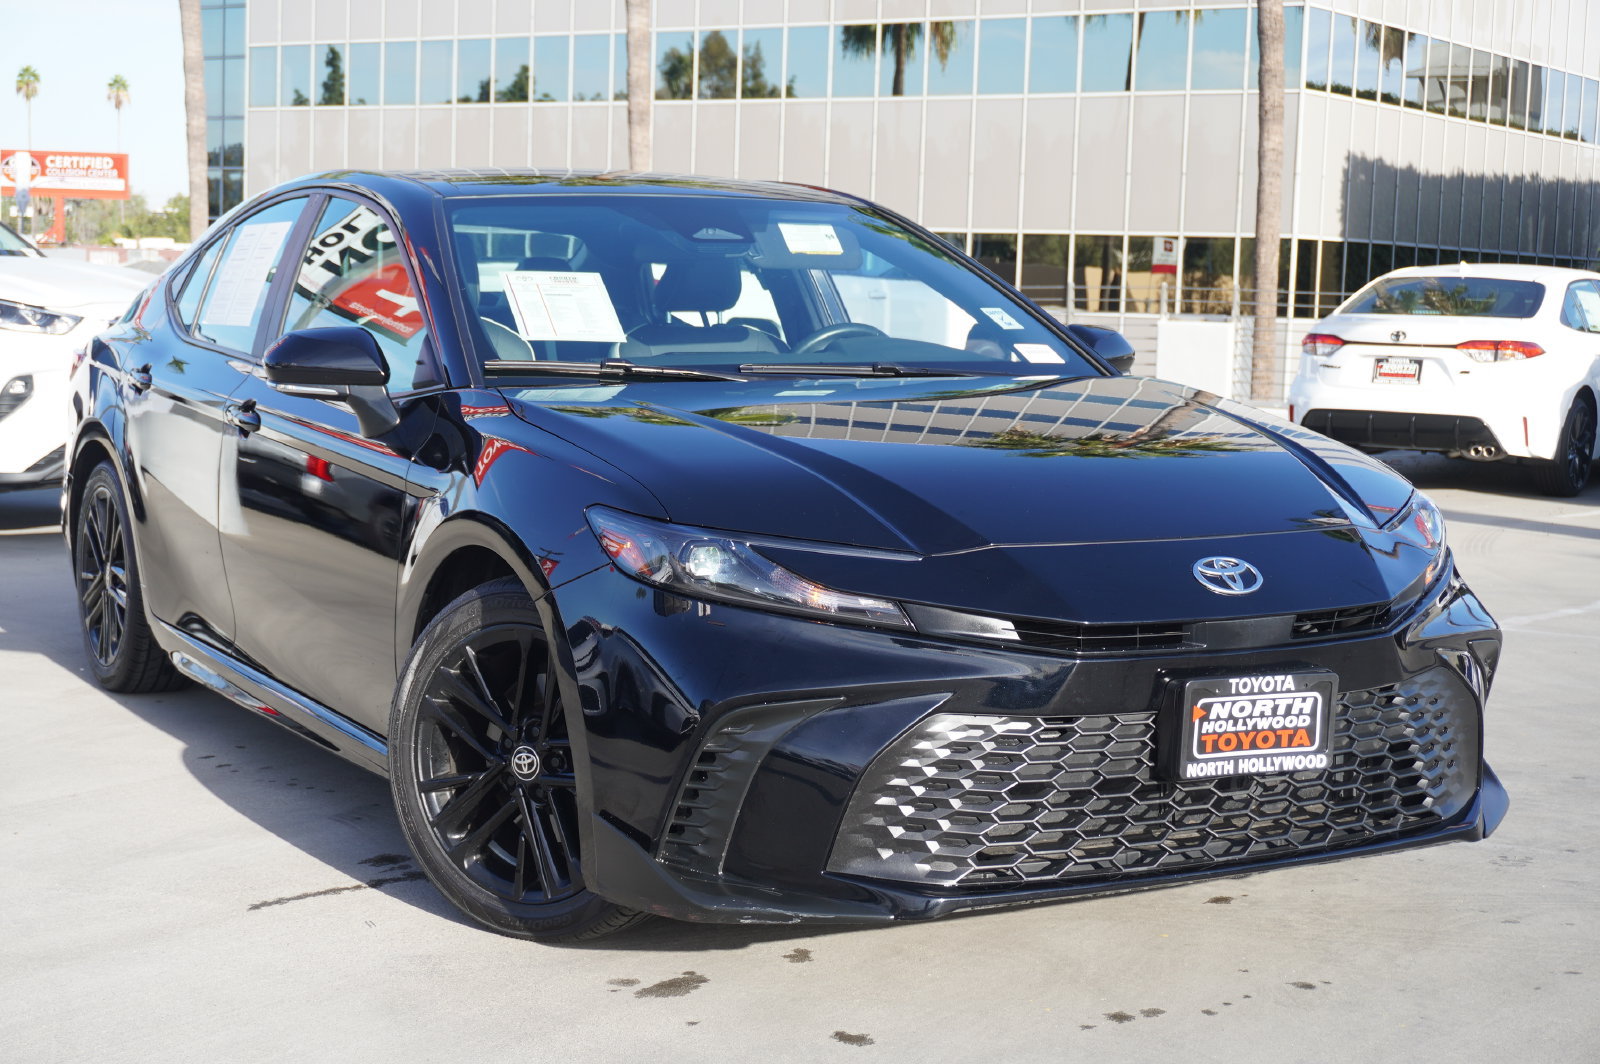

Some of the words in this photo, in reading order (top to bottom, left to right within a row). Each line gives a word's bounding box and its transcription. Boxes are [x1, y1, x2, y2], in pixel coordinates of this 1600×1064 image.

[46, 155, 114, 169] CERTIFIED
[1229, 675, 1295, 694] TOYOTA
[1209, 697, 1314, 719] NORTH
[1201, 715, 1311, 733] HOLLYWOOD
[1201, 729, 1311, 753] TOYOTA
[1187, 759, 1234, 777] NORTH
[1238, 754, 1327, 773] HOLLYWOOD
